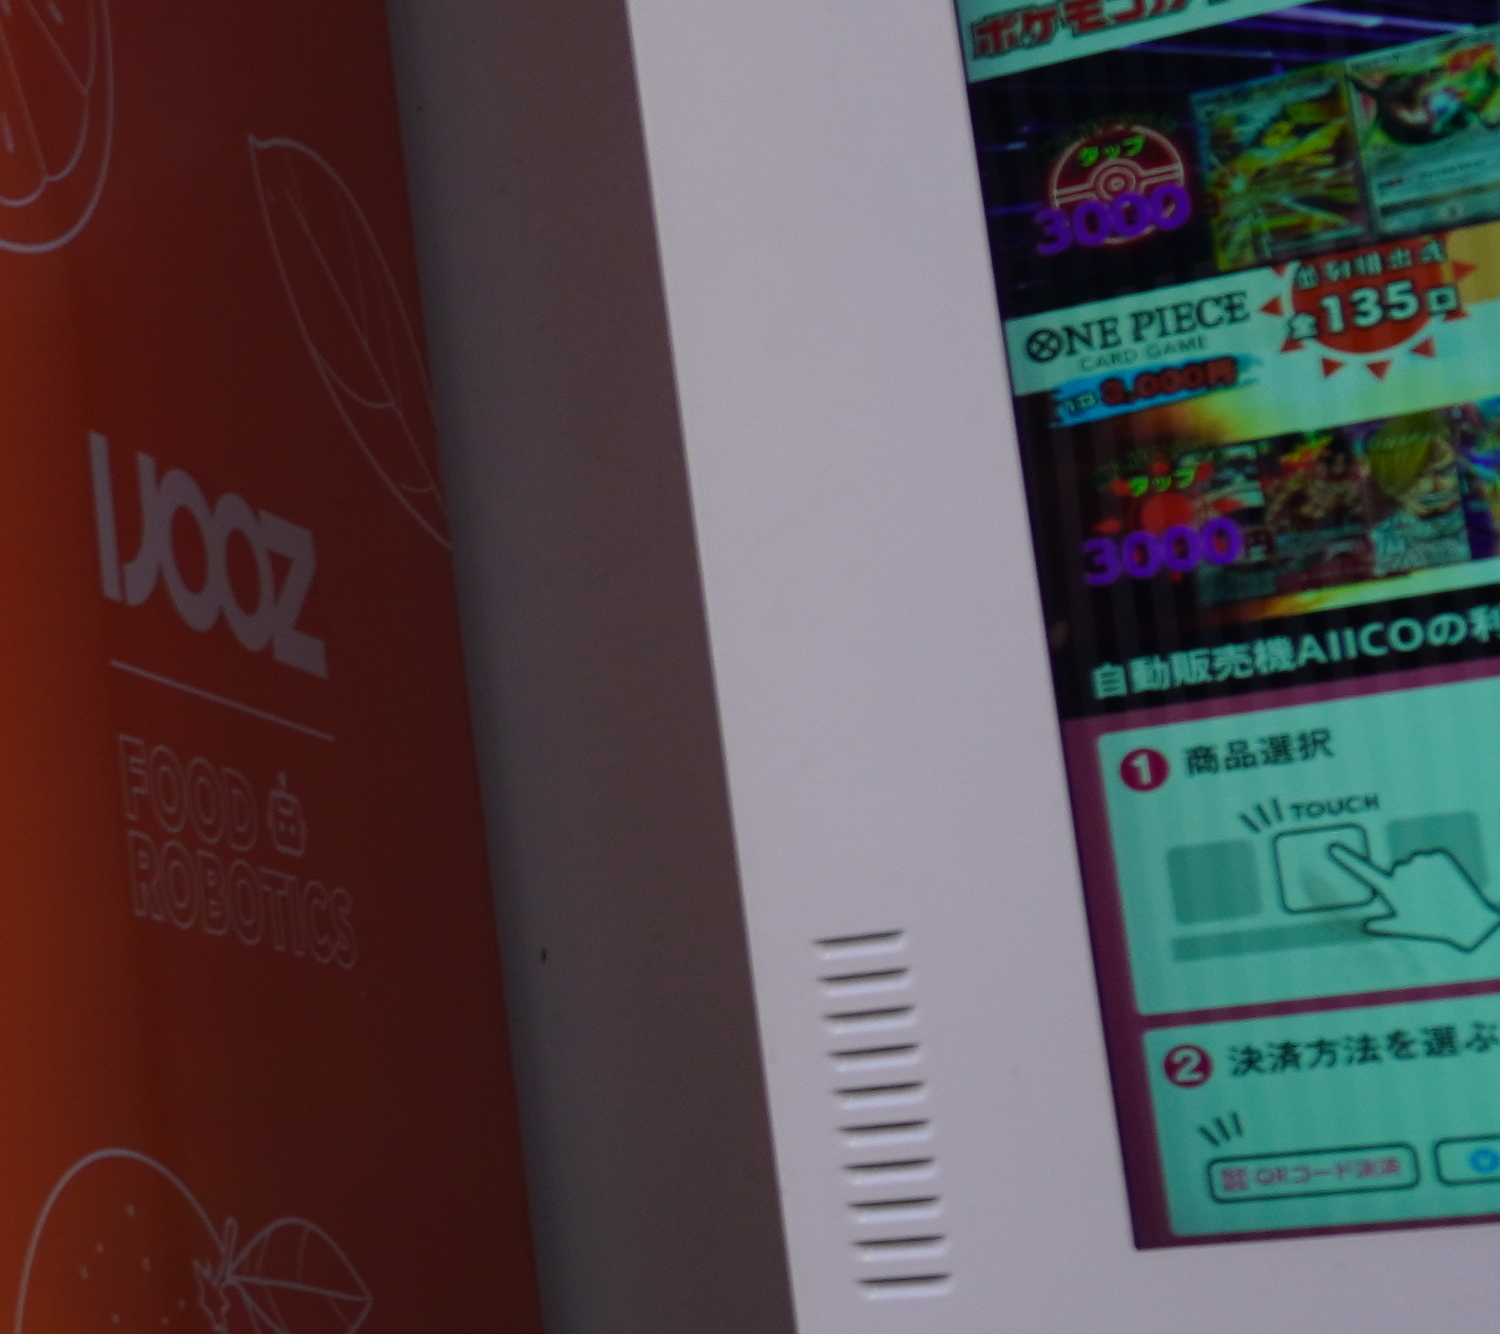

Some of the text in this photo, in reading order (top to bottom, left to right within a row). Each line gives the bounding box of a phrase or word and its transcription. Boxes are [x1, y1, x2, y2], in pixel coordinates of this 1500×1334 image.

[1035, 183, 1191, 257] 3000
[1130, 290, 1250, 343] PIECE
[1080, 335, 1208, 374] CARD GAME
[1083, 517, 1243, 587] 3000
[1184, 728, 1336, 779] 商品選択
[117, 732, 258, 854] FOOD
[1289, 794, 1381, 819] TOUCH
[128, 828, 358, 969] ROBOTICS
